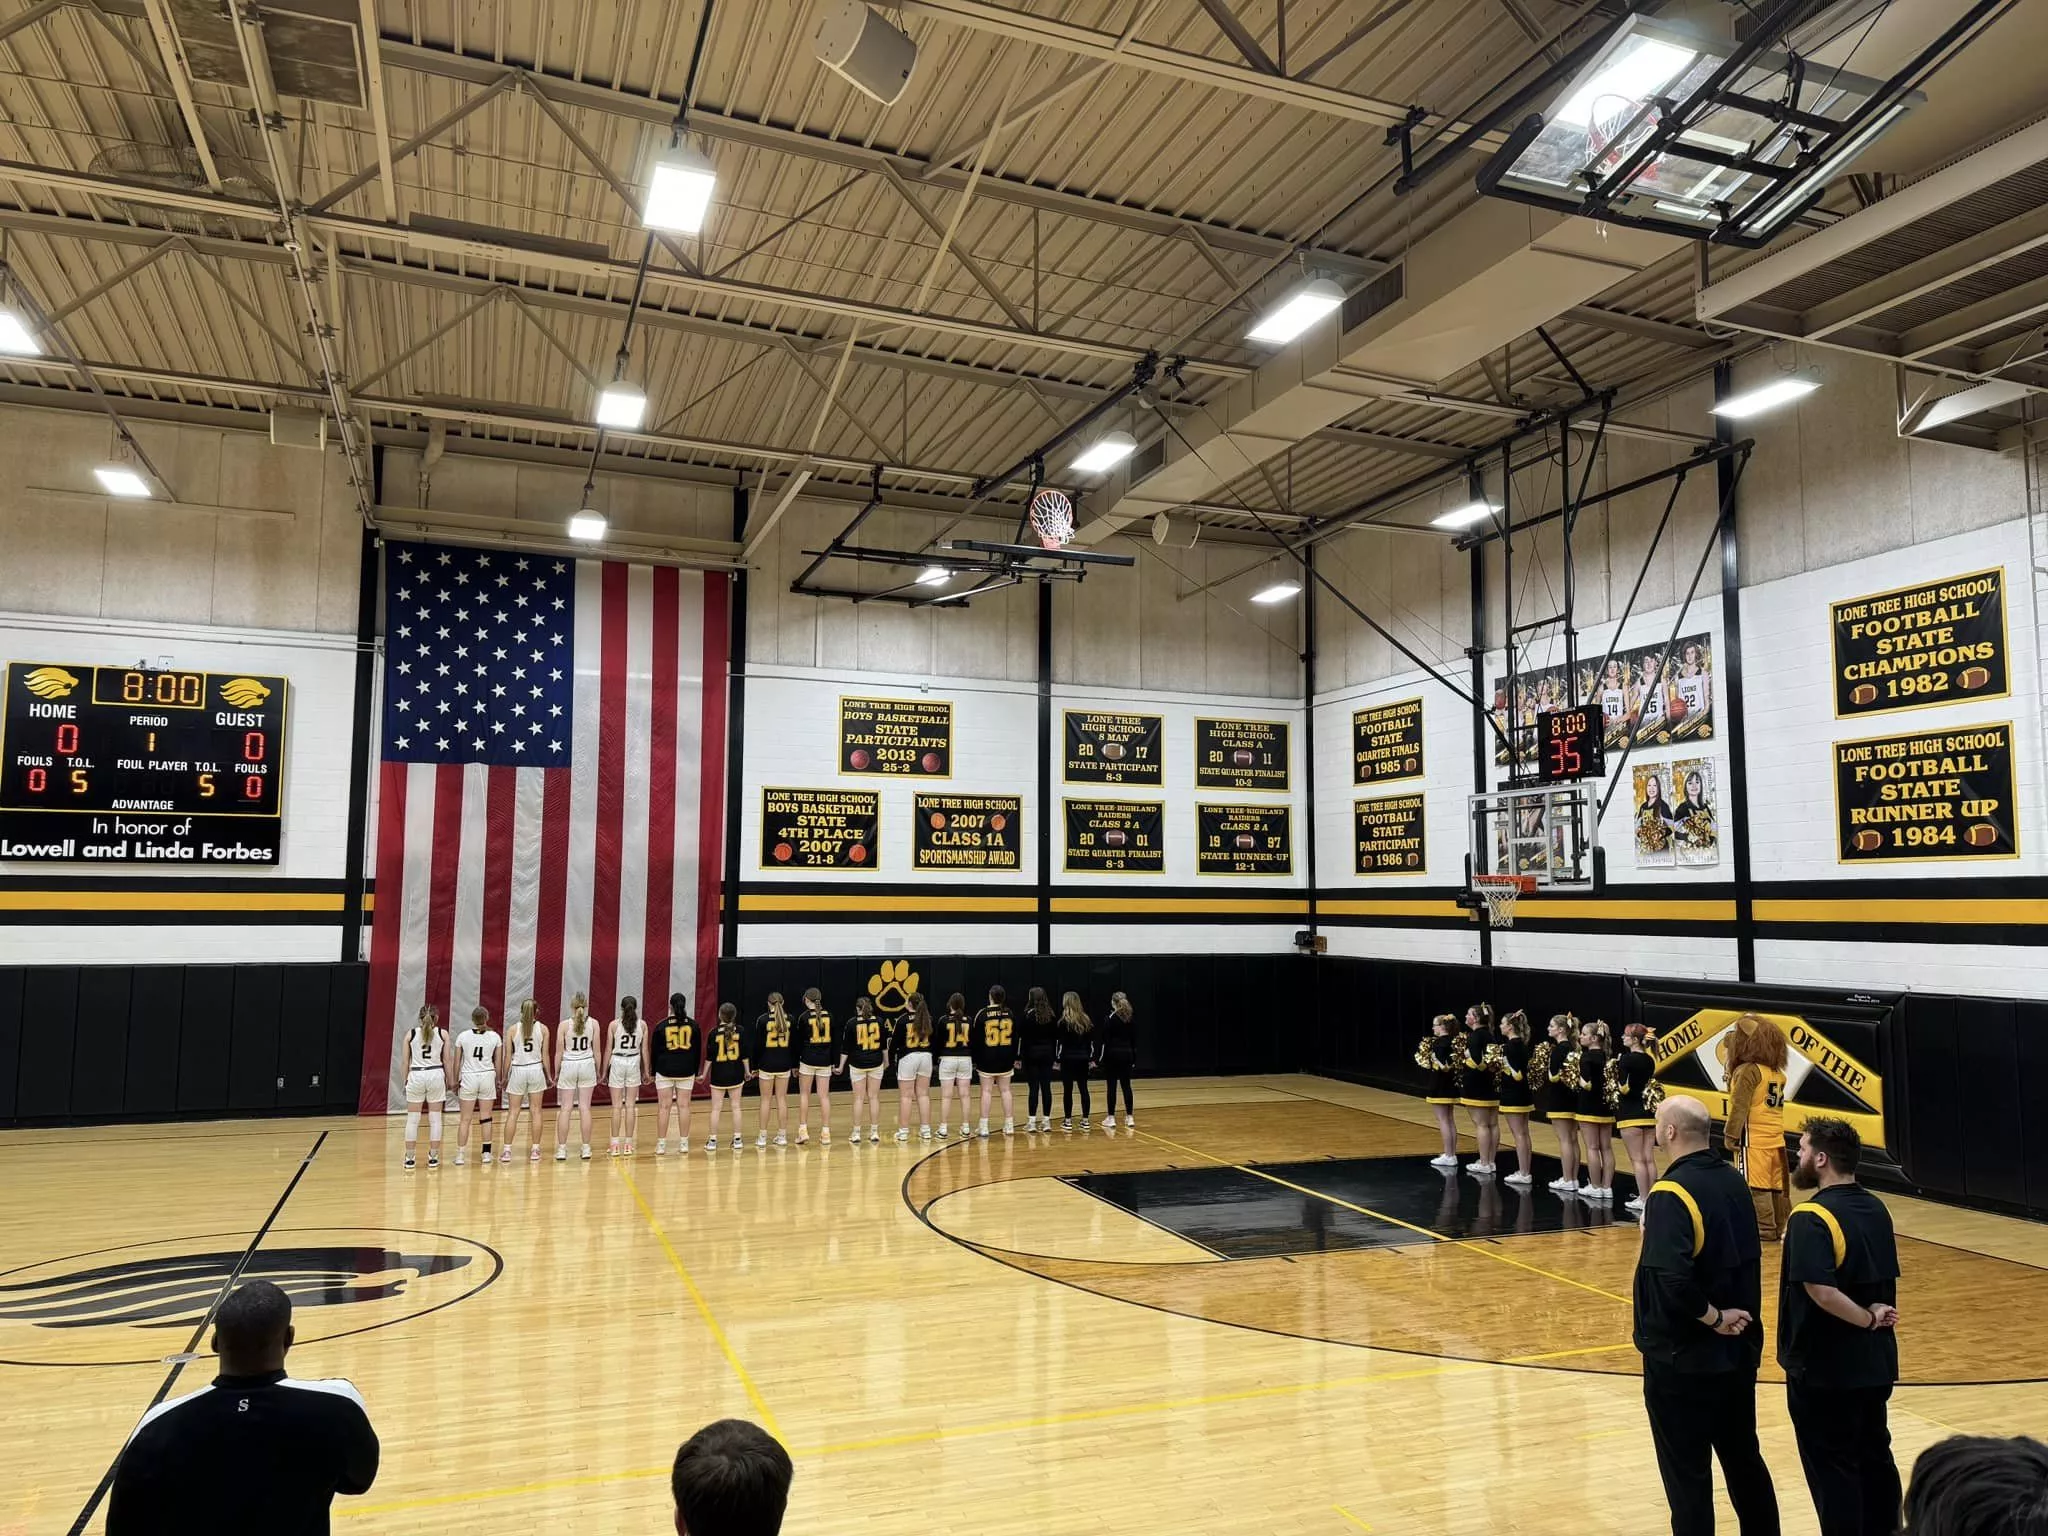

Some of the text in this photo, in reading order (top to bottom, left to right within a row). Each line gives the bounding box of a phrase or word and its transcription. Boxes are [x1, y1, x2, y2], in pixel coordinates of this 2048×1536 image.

[1838, 578, 1996, 623] LONE TREE HIGH SCHOOL
[1852, 601, 1980, 639] FOOTBALL
[1876, 627, 1954, 655] STATE
[1844, 642, 1994, 680] CHAMPIONS
[123, 673, 200, 704] 8:00
[1887, 672, 1949, 698] 1982
[29, 704, 77, 719] HOME
[869, 702, 891, 710] TREE
[918, 705, 949, 713] SCHOOL
[1608, 705, 1618, 715] 14
[130, 715, 168, 726] PERIOD
[215, 712, 265, 727] GUEST
[844, 712, 949, 724] BOYS BASKETBALL
[1087, 715, 1141, 725] LONE TREE
[1552, 713, 1586, 736] 8:00
[875, 724, 918, 735] STATE
[1108, 725, 1146, 734] SCHOOL
[1215, 722, 1269, 732] LONE TREE
[1361, 717, 1414, 736] FOOTBALL
[57, 724, 78, 753] 0
[846, 734, 947, 748] PARTICIPANTS
[1210, 730, 1275, 740] HIGH SCHOOL
[1371, 732, 1403, 746] STATE
[149, 733, 155, 752] 1
[244, 732, 264, 760] 0
[1223, 740, 1254, 748] CLASS
[1841, 732, 2004, 762] LONE TREE HIGH SCHOOL
[877, 749, 916, 761] 2013
[1079, 744, 1147, 758] 20 17
[1209, 751, 1223, 762] 20
[1357, 743, 1420, 762] QUARTER FINALS
[1550, 737, 1580, 774] 35
[17, 756, 52, 766] FOULS
[67, 758, 95, 768] T.O.L.
[117, 760, 187, 771] FOUL PLAYER
[195, 762, 221, 772] T.O.L.
[883, 763, 910, 772] 25-2
[1068, 761, 1158, 772] STATE PARTICIPANT
[1375, 760, 1400, 774] 1985
[235, 764, 267, 774] FOULS
[1200, 767, 1220, 775] STATE
[1221, 768, 1254, 776] QUARTER
[1855, 755, 1988, 782] FOOTBALL
[29, 768, 46, 792] 0
[71, 770, 88, 793] 5
[200, 775, 215, 796] 5
[246, 776, 262, 797] 0
[1881, 779, 1961, 800] STATE
[767, 792, 876, 803] LONE TREE HIGH SCHOOL
[918, 798, 1017, 810] LONE TREE HIGH SCHOOL
[112, 800, 174, 810] ADVANTAGE
[768, 803, 874, 815] BOYS BASKETBALL
[1851, 799, 1999, 824] RUNNER UP
[797, 815, 846, 827] STATE
[951, 815, 985, 828] 2007
[1089, 820, 1120, 828] CLASS
[1362, 811, 1415, 825] FOOTBALL
[93, 816, 192, 835] In honor of
[1372, 825, 1405, 838] STATE
[778, 828, 864, 839] 4TH PLACE
[932, 832, 1004, 846] CLASS 1A
[1080, 833, 1148, 846] 20 01
[1892, 825, 1956, 846] 1984
[1, 839, 272, 860] Lowell and Linda Forbes
[799, 841, 842, 852] 2007
[1267, 837, 1281, 848] 97
[1360, 838, 1420, 851] PARTICIPANT
[807, 855, 834, 864] 21-8
[920, 849, 1015, 864] SPORTSMANSHIP AWARD
[1200, 852, 1288, 861] STATE RUNNER-UP
[1377, 853, 1402, 866] 1986
[664, 1025, 692, 1050] 50
[808, 1017, 832, 1044] 11
[856, 1023, 880, 1050] 42
[571, 1036, 588, 1051] 10
[620, 1034, 636, 1049] 21
[1656, 1019, 1704, 1062] HOME
[422, 1045, 431, 1059] 2
[473, 1047, 483, 1061] 4
[1789, 1025, 1866, 1092] OF THE
[238, 1399, 249, 1412] S
